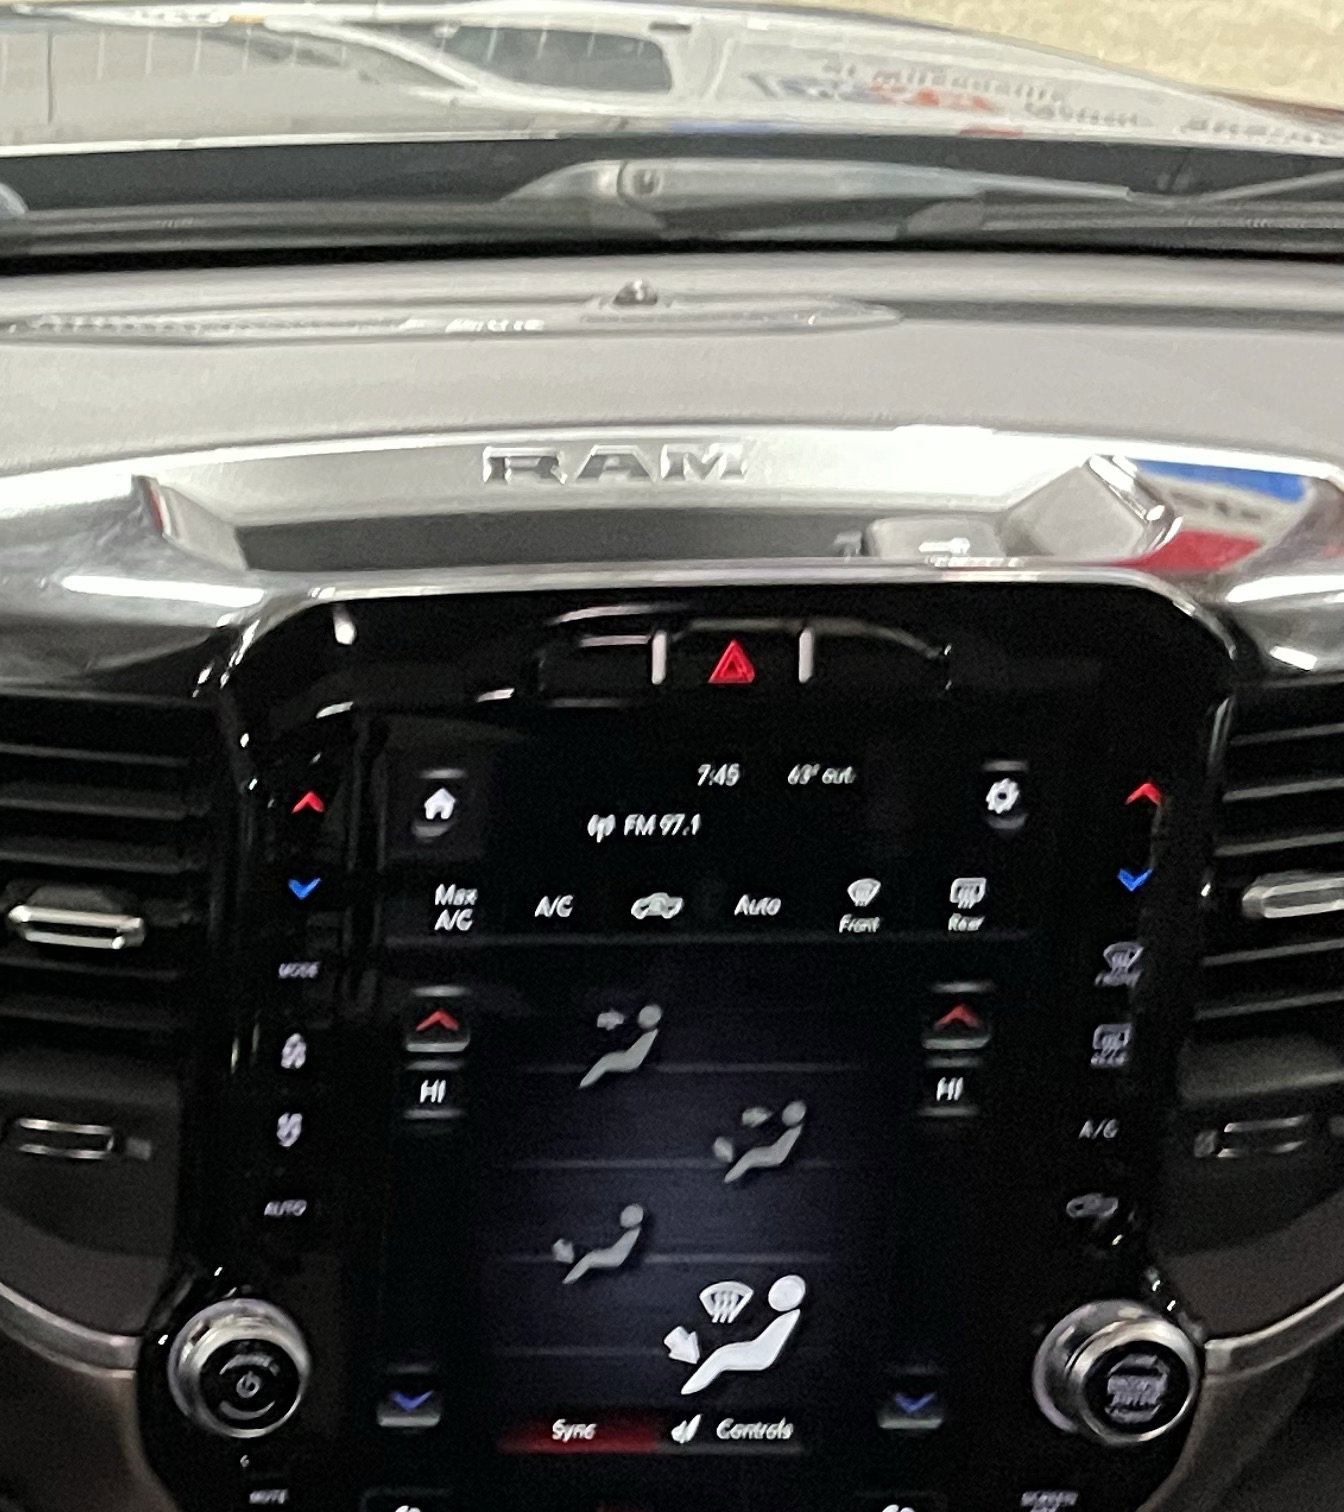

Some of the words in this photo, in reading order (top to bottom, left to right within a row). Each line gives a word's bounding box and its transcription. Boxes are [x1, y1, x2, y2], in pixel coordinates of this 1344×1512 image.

[481, 444, 750, 486] RAM
[623, 813, 657, 837] FM
[659, 813, 701, 837] 97.1
[534, 894, 574, 918] A/C
[434, 908, 473, 931] A/C
[419, 1079, 447, 1103] HI
[552, 1418, 597, 1443] Sync
[716, 1416, 794, 1440] Controls
